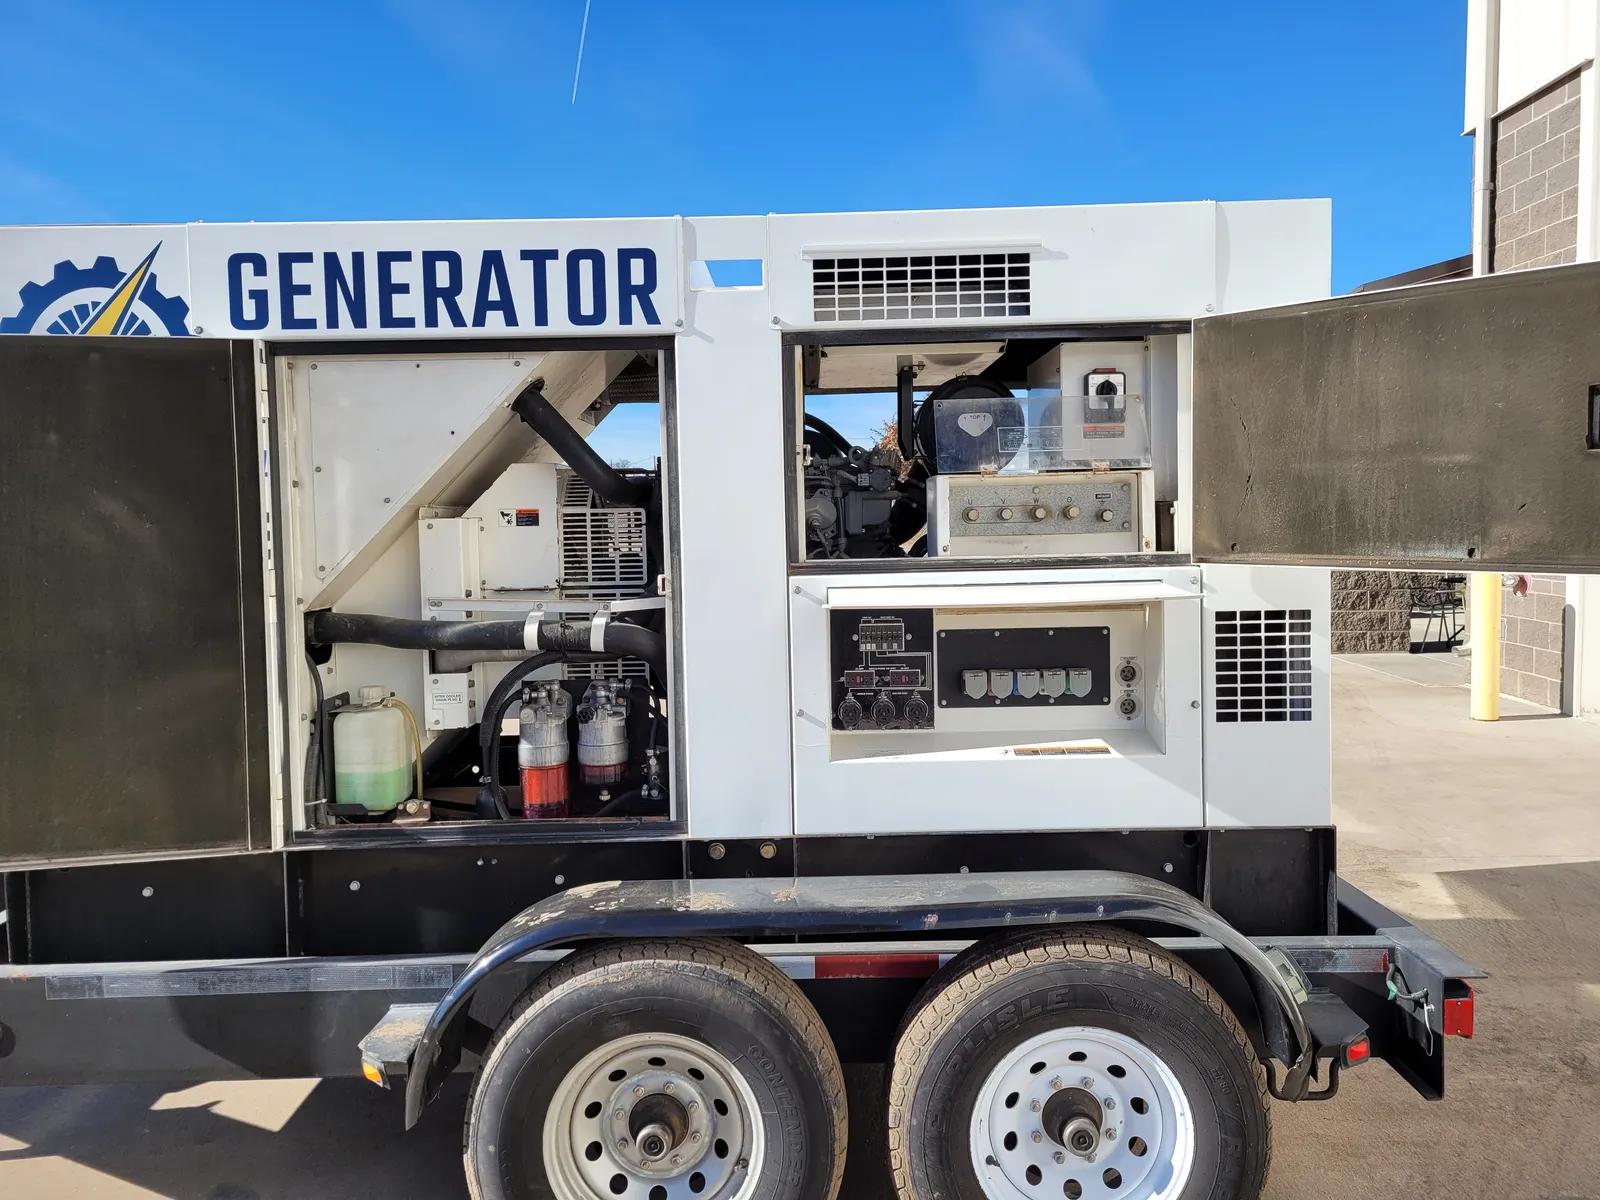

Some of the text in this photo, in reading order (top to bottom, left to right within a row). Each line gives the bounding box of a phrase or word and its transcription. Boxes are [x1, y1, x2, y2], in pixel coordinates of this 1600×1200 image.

[228, 248, 661, 330] GENERATOR
[748, 1043, 804, 1188] CONTENDER
[930, 988, 1070, 1132] CARLISLE
